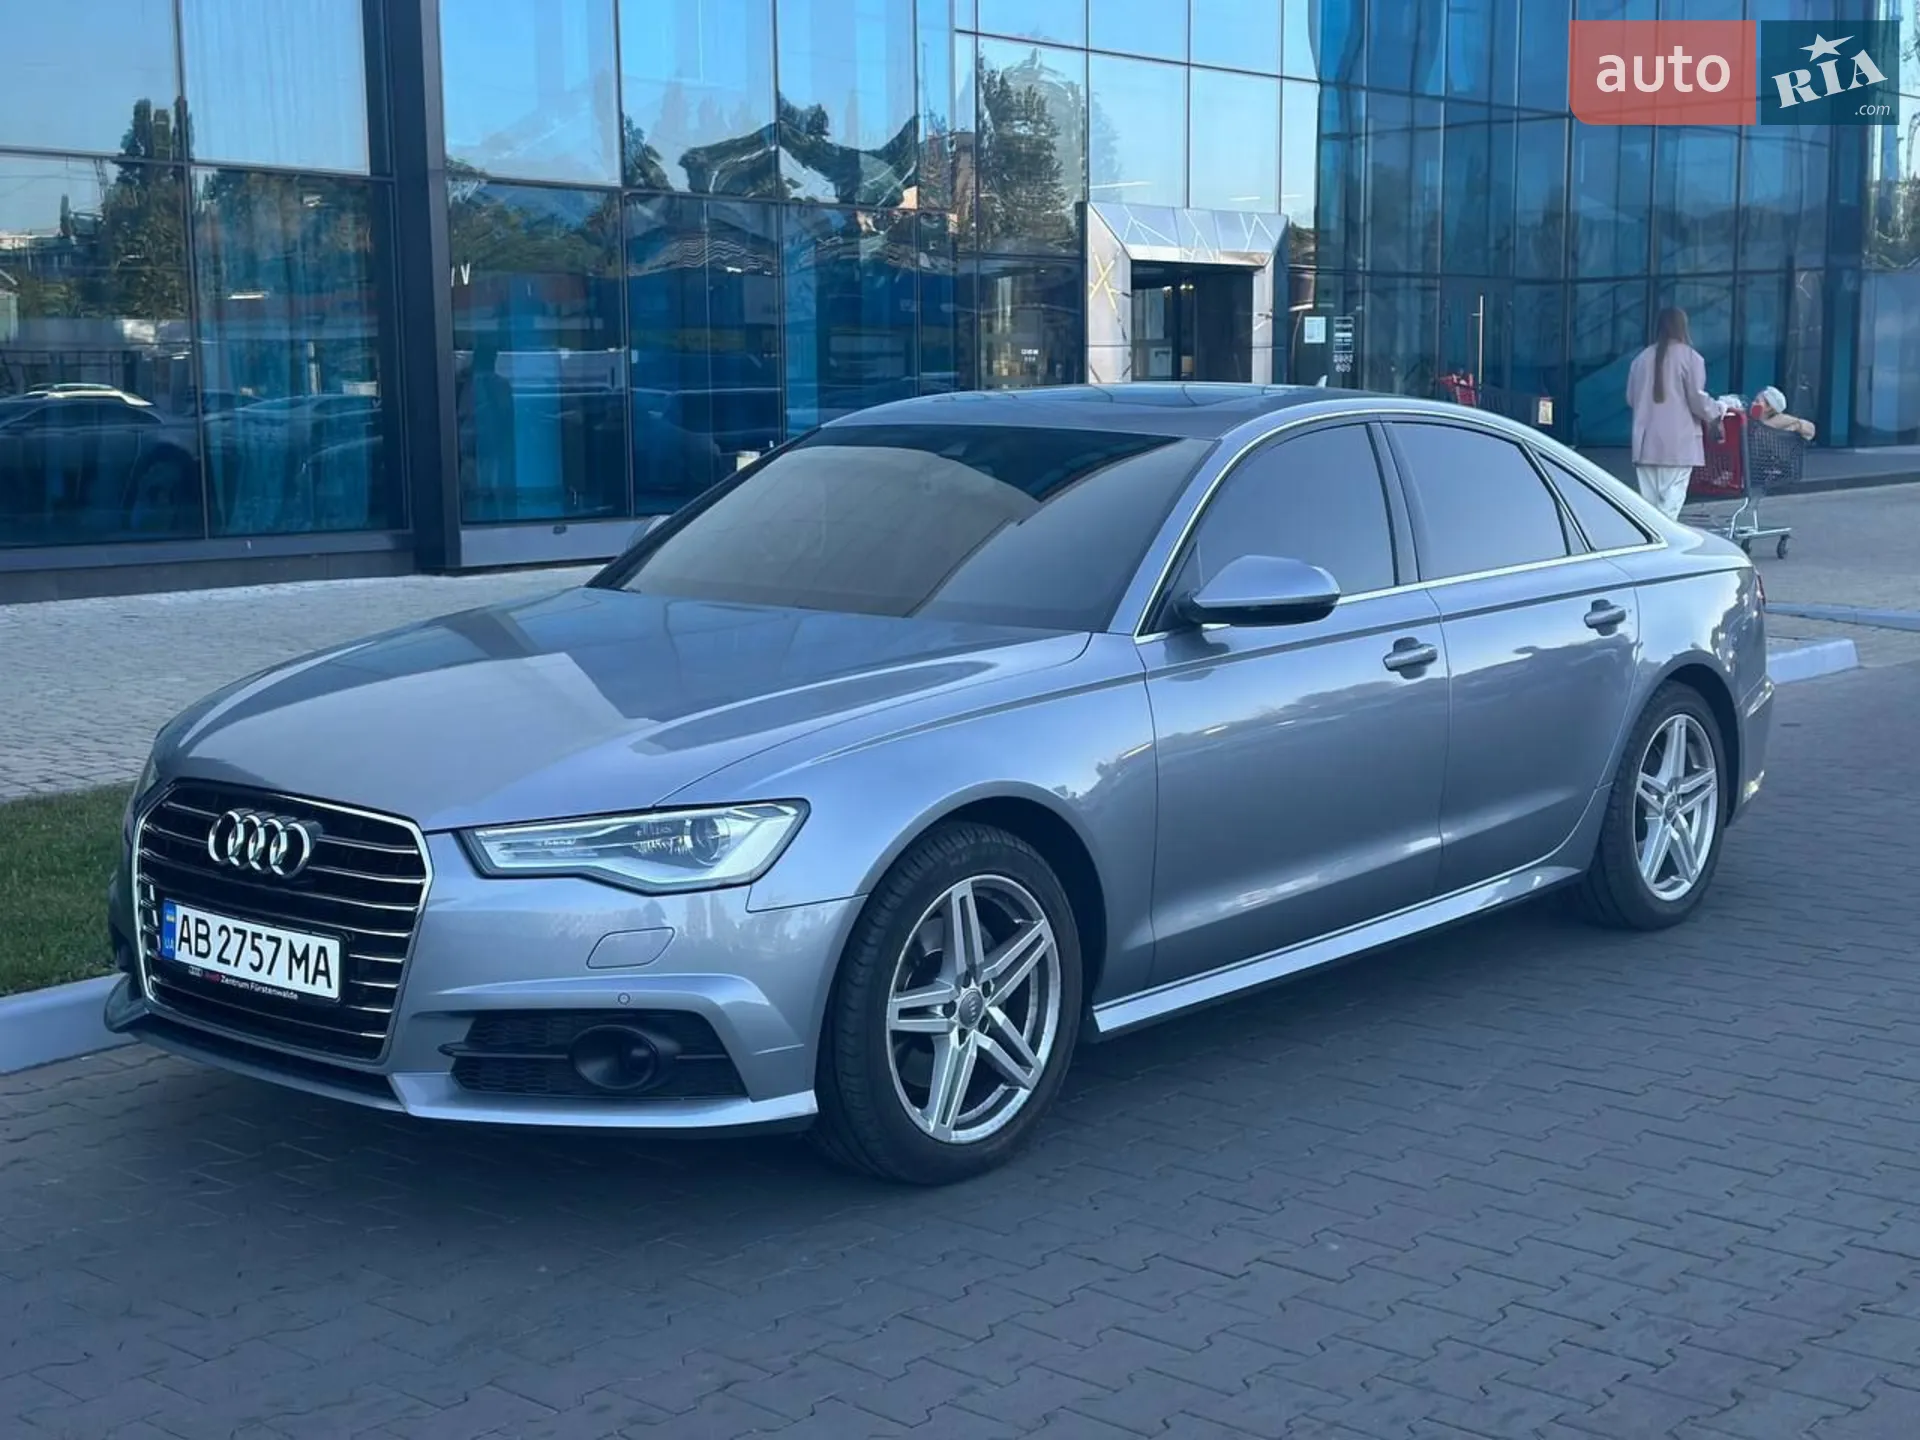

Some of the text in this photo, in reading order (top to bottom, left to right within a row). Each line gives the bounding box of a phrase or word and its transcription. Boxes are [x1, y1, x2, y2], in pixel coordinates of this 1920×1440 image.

[178, 914, 332, 989] AB 2757 MA
[220, 975, 249, 990] Zentrum
